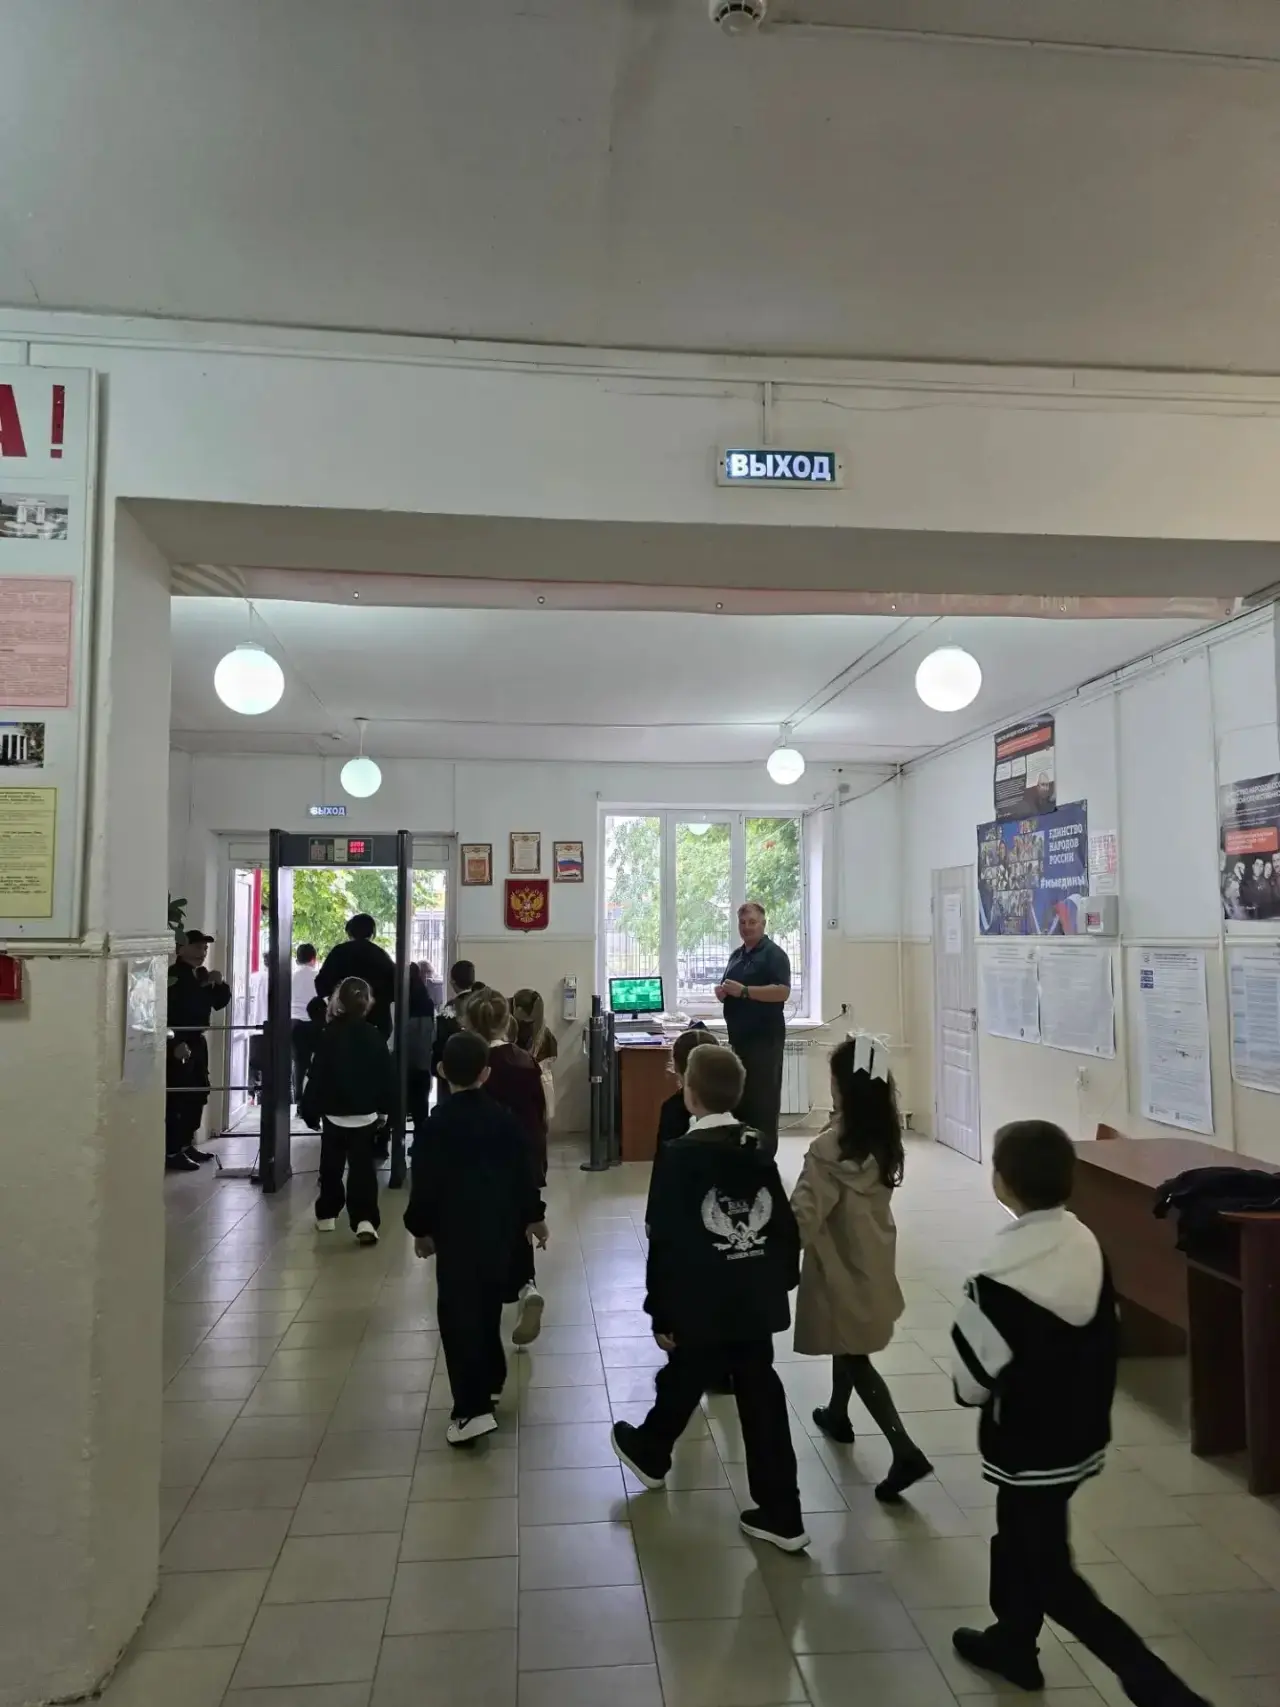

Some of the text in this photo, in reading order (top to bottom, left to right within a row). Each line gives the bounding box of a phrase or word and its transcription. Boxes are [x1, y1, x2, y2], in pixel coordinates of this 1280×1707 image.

[731, 453, 832, 481] ВЫХОД
[309, 806, 345, 815] ВЫХОД
[1049, 824, 1082, 838] ЕДИНСТВО
[1049, 838, 1079, 852] НАРОДОВ
[1049, 852, 1074, 865] РОССИИ
